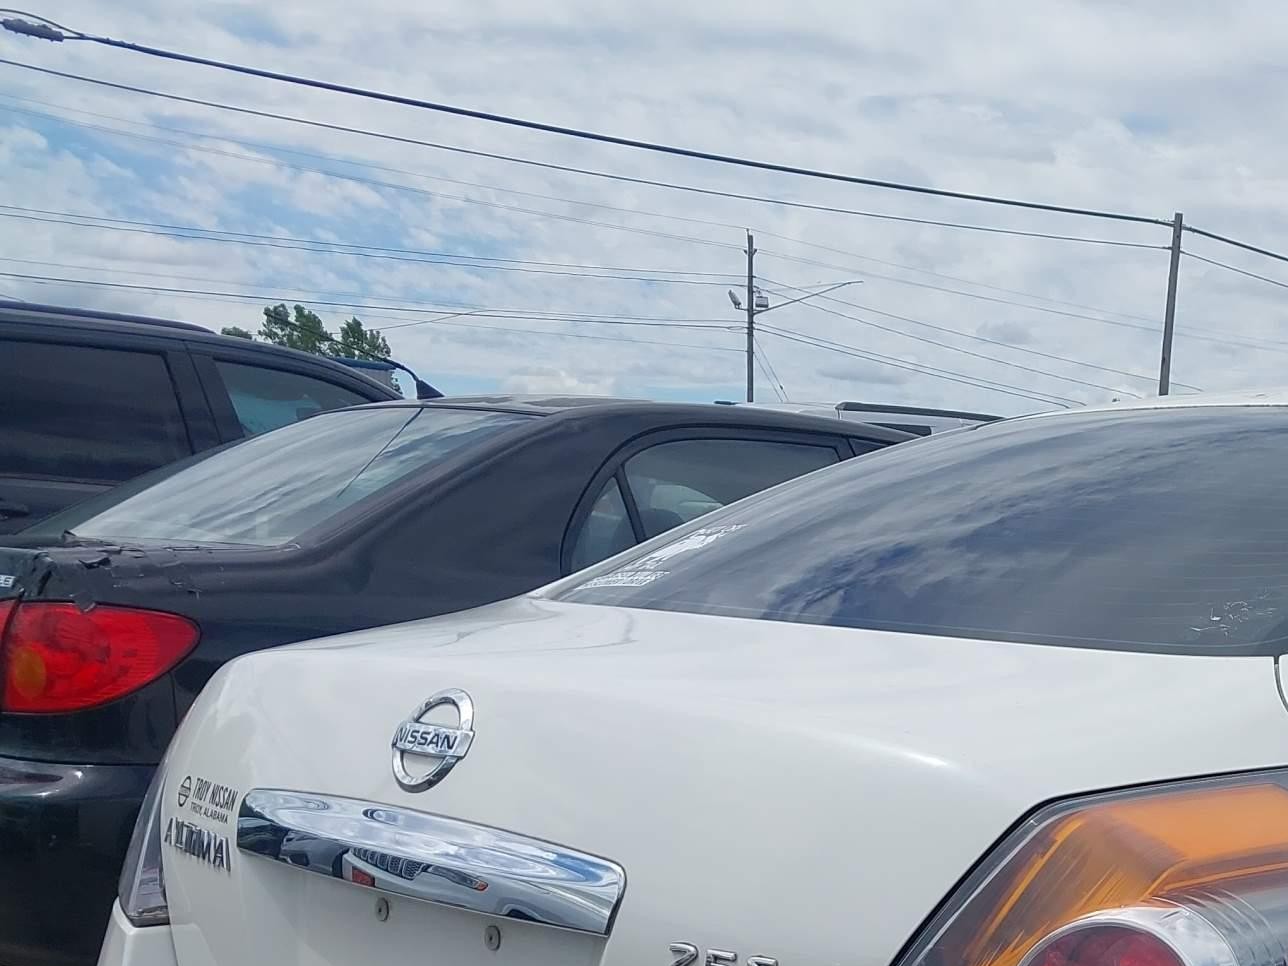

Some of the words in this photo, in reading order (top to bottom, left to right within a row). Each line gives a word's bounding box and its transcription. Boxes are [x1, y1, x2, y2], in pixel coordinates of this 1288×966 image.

[397, 727, 458, 750] NISSAN
[193, 778, 212, 802] TROY
[209, 784, 239, 812] NISSAN
[203, 806, 228, 825] ALABAMA
